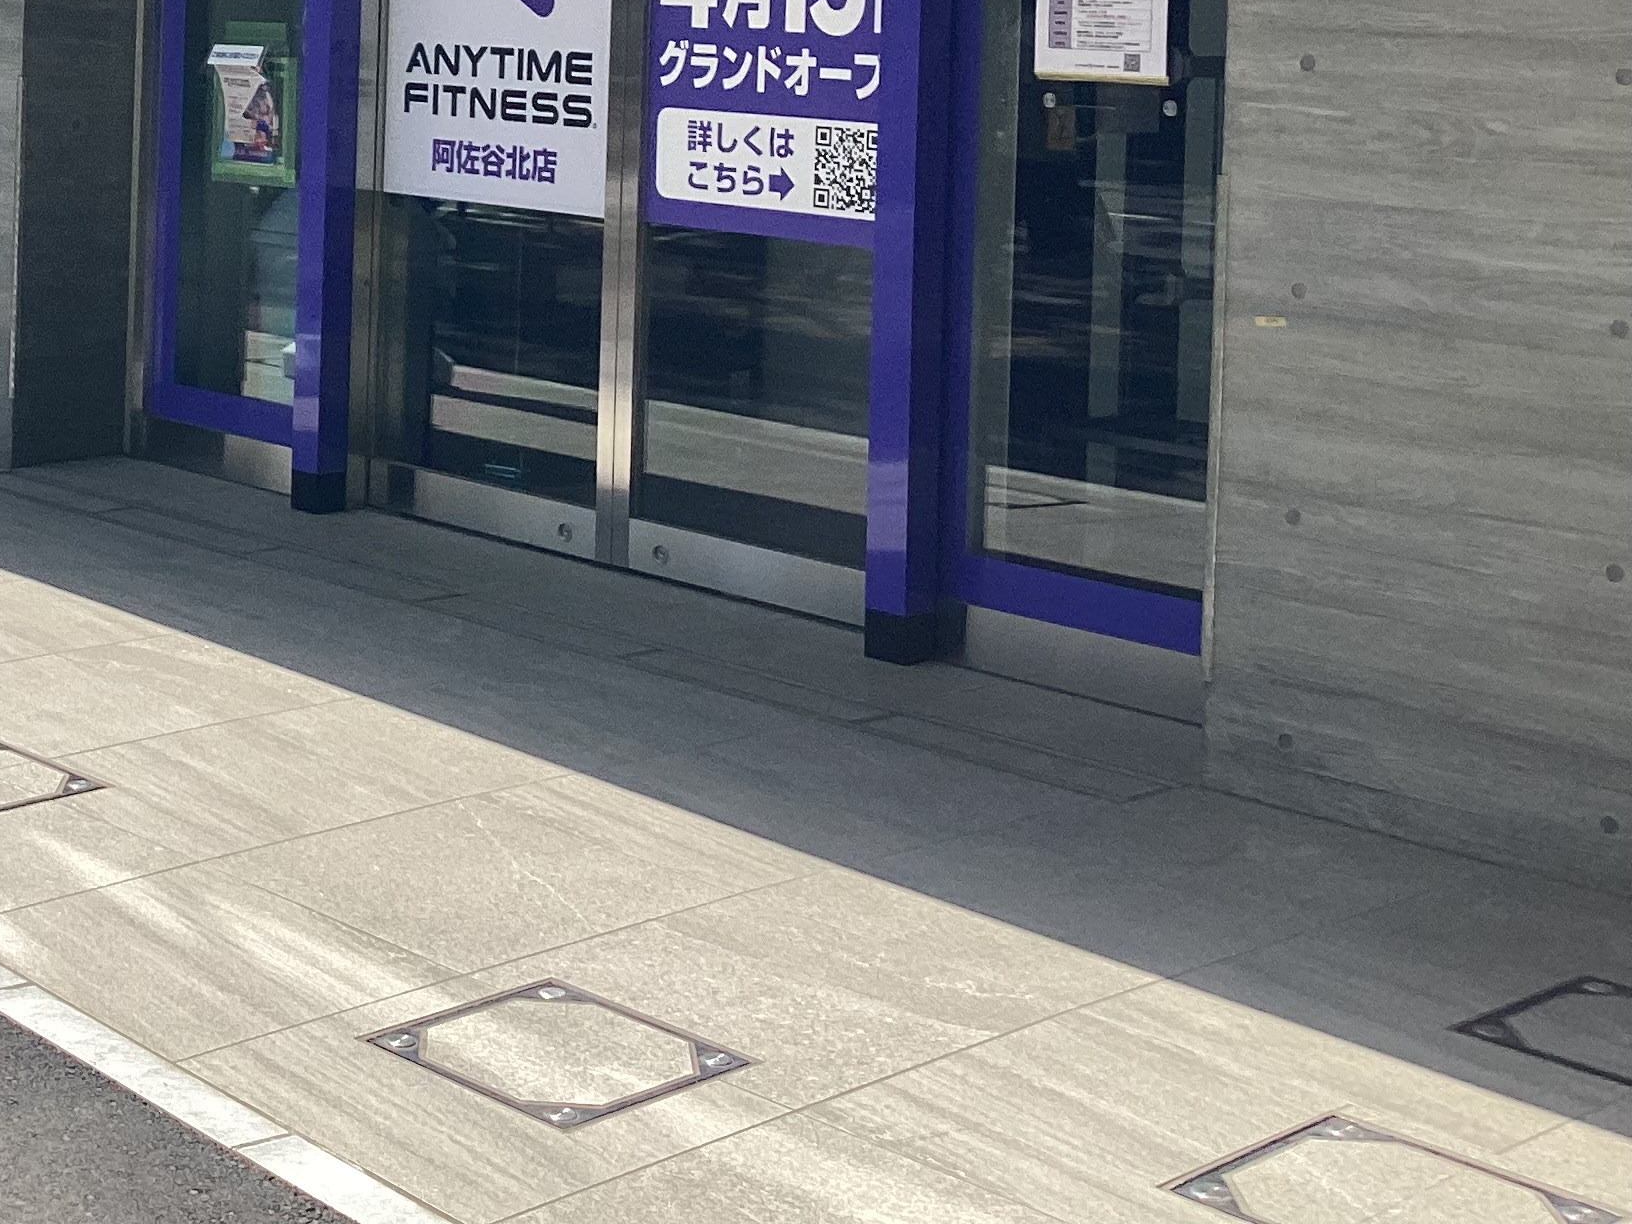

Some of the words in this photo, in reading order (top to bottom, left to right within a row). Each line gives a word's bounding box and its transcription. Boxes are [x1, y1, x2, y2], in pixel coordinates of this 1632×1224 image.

[405, 42, 593, 85] ANYTIME
[403, 81, 594, 128] FITNESS
[687, 119, 795, 158] 詳しくは
[431, 139, 558, 184] 阿佐谷北店
[687, 163, 763, 196] こちら
